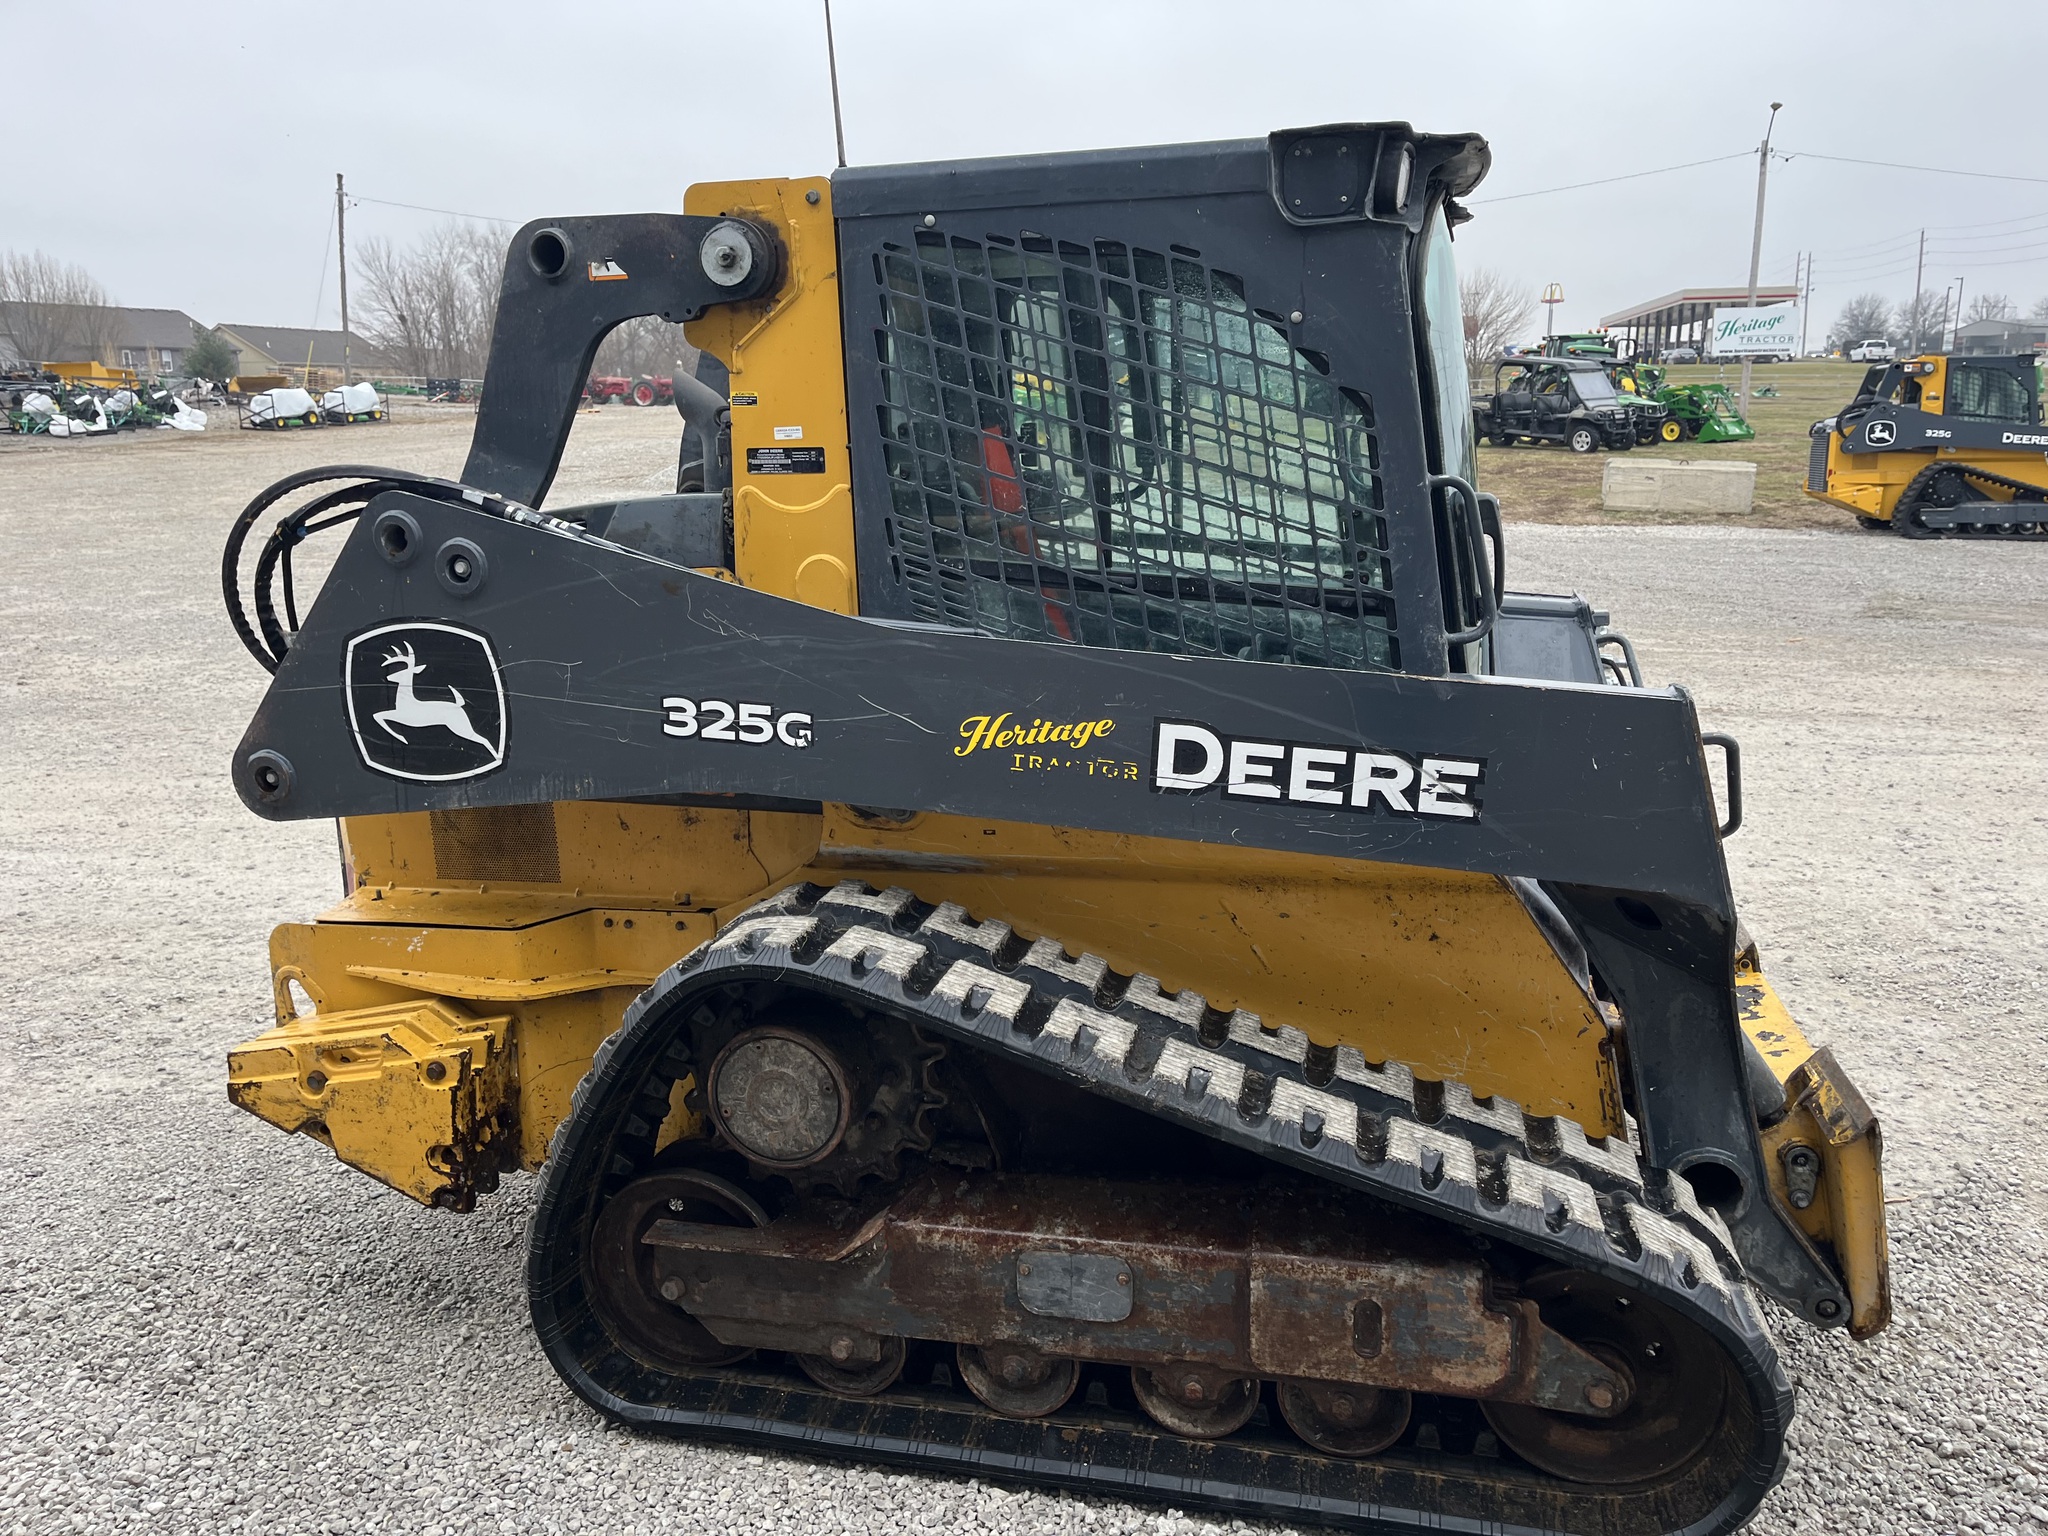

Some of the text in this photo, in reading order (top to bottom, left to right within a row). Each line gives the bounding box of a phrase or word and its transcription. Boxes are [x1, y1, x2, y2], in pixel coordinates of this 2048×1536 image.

[1714, 314, 1785, 341] Heritage
[1740, 335, 1795, 344] TRACTOR
[1925, 429, 1952, 438] 325G
[2001, 432, 2048, 445] DEERE
[663, 697, 812, 747] 325G
[954, 712, 1116, 757] Heritage
[1011, 753, 1138, 780] TRATOR
[1156, 723, 1480, 817] DEERE
